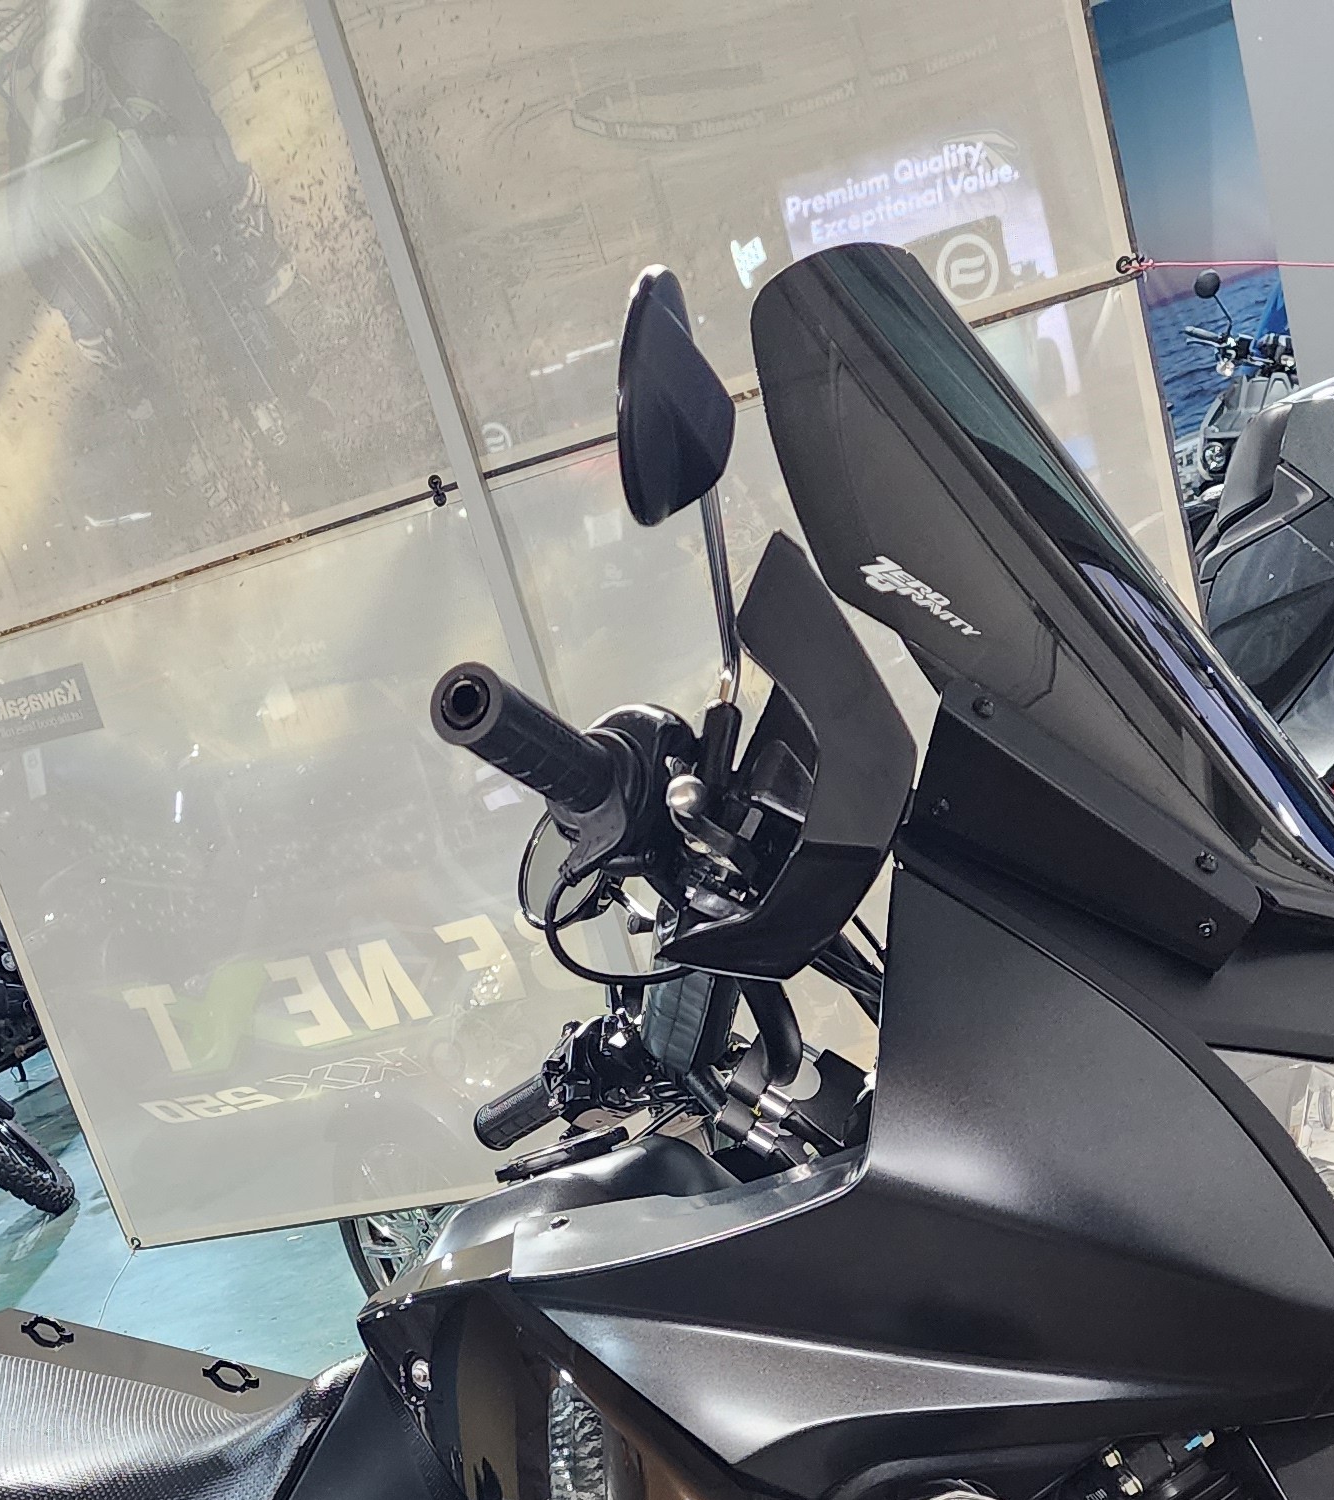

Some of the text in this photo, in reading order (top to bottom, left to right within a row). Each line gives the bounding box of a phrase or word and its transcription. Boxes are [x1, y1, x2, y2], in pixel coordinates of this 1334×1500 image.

[785, 172, 889, 223] Premium
[810, 179, 944, 244] Exceptional
[859, 555, 951, 607] ZERO
[865, 575, 982, 636] GRAVITY
